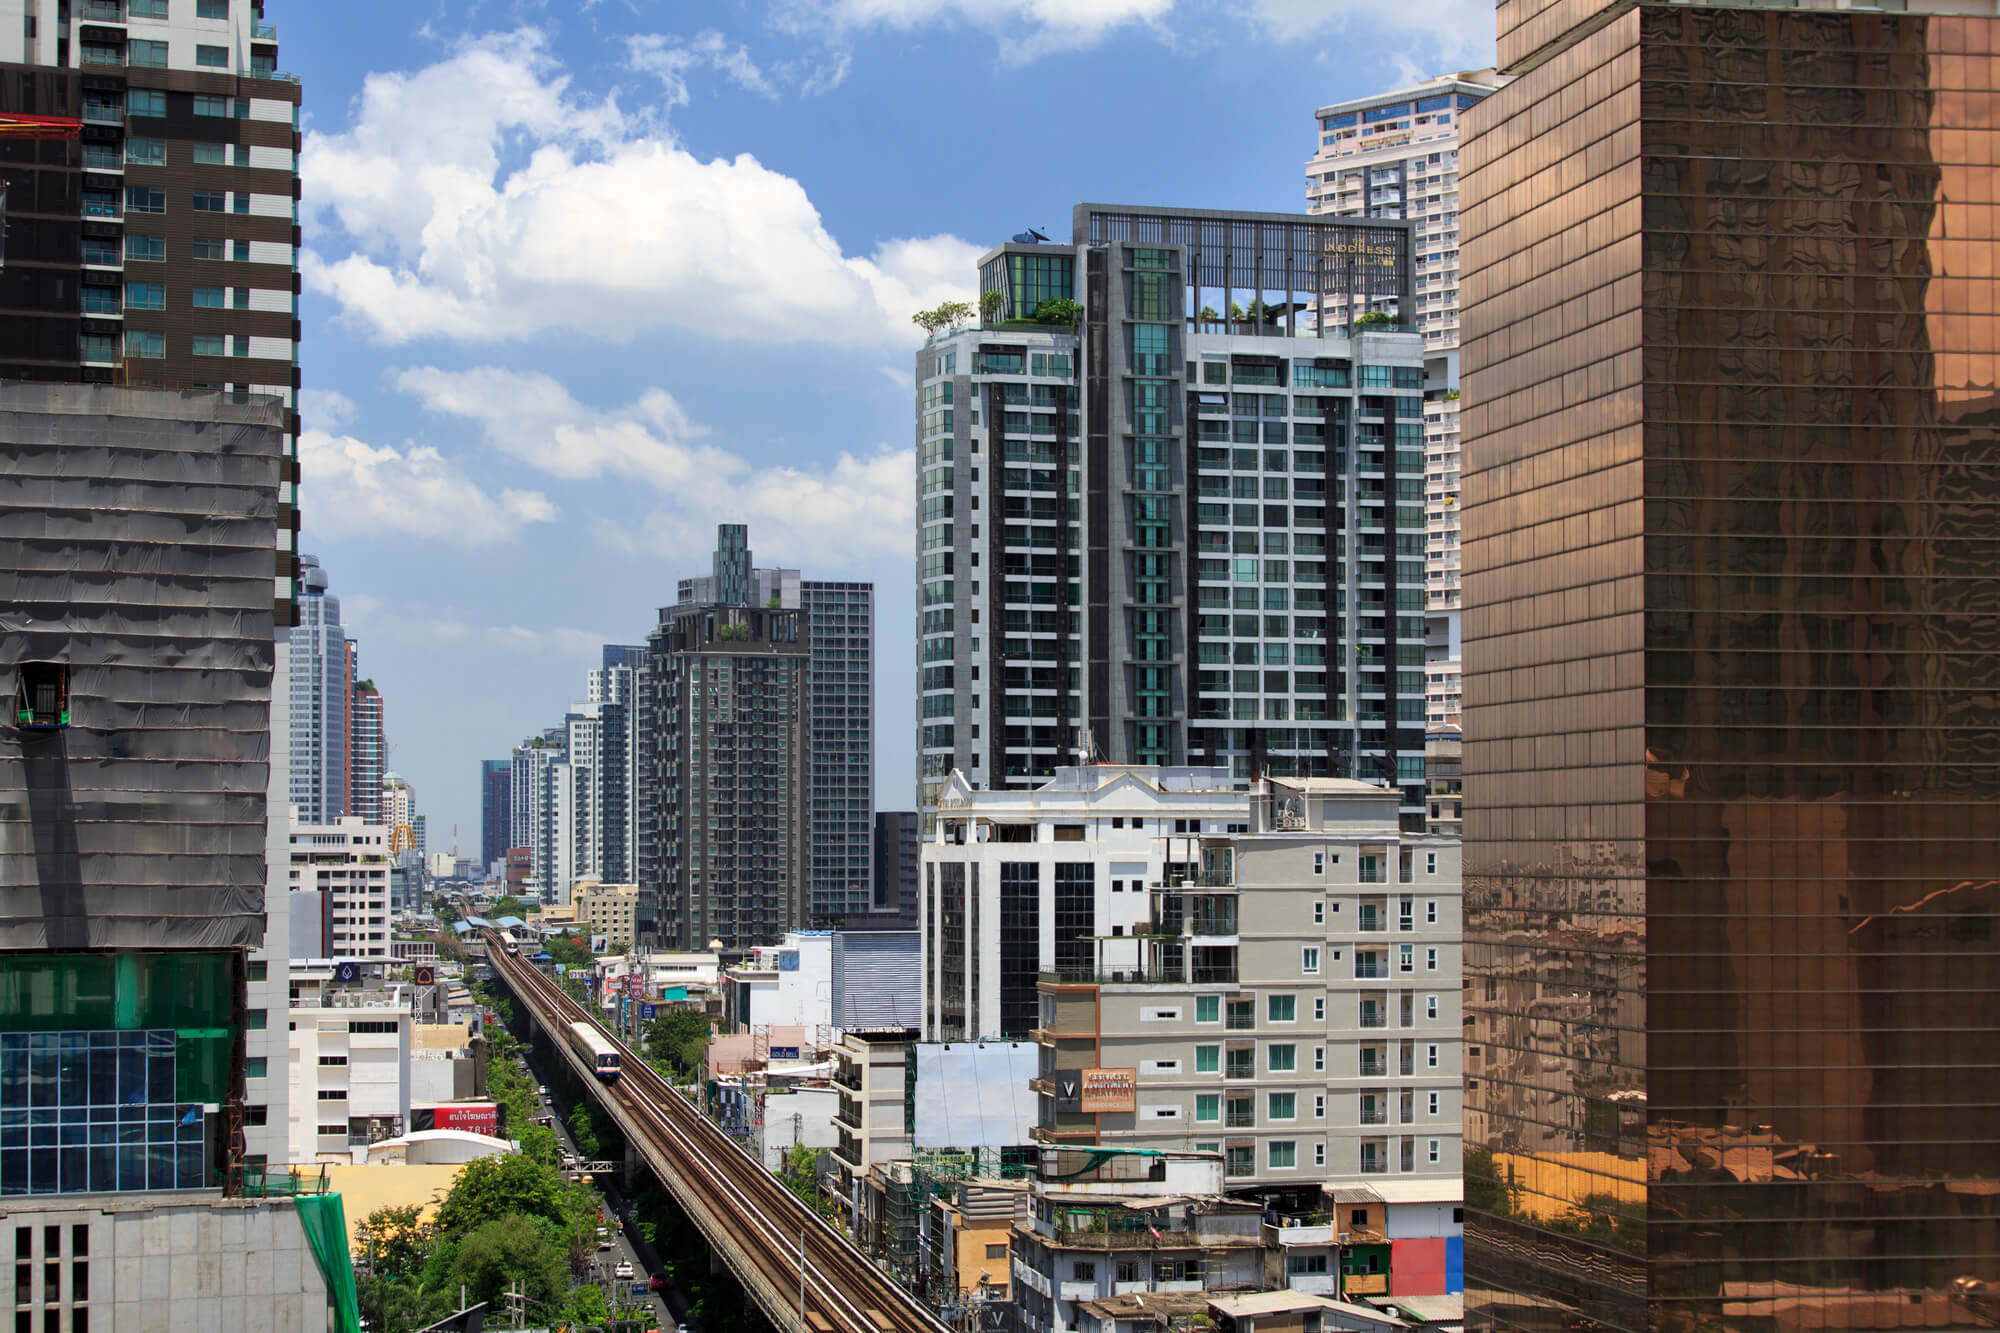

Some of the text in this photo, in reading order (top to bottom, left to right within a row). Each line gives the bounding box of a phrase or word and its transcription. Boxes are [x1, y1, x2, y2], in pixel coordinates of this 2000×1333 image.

[1325, 243, 1392, 255] ADDRESS
[1063, 1081, 1076, 1097] V
[1084, 1081, 1134, 1089] APARTMENT
[992, 1311, 1004, 1327] V
